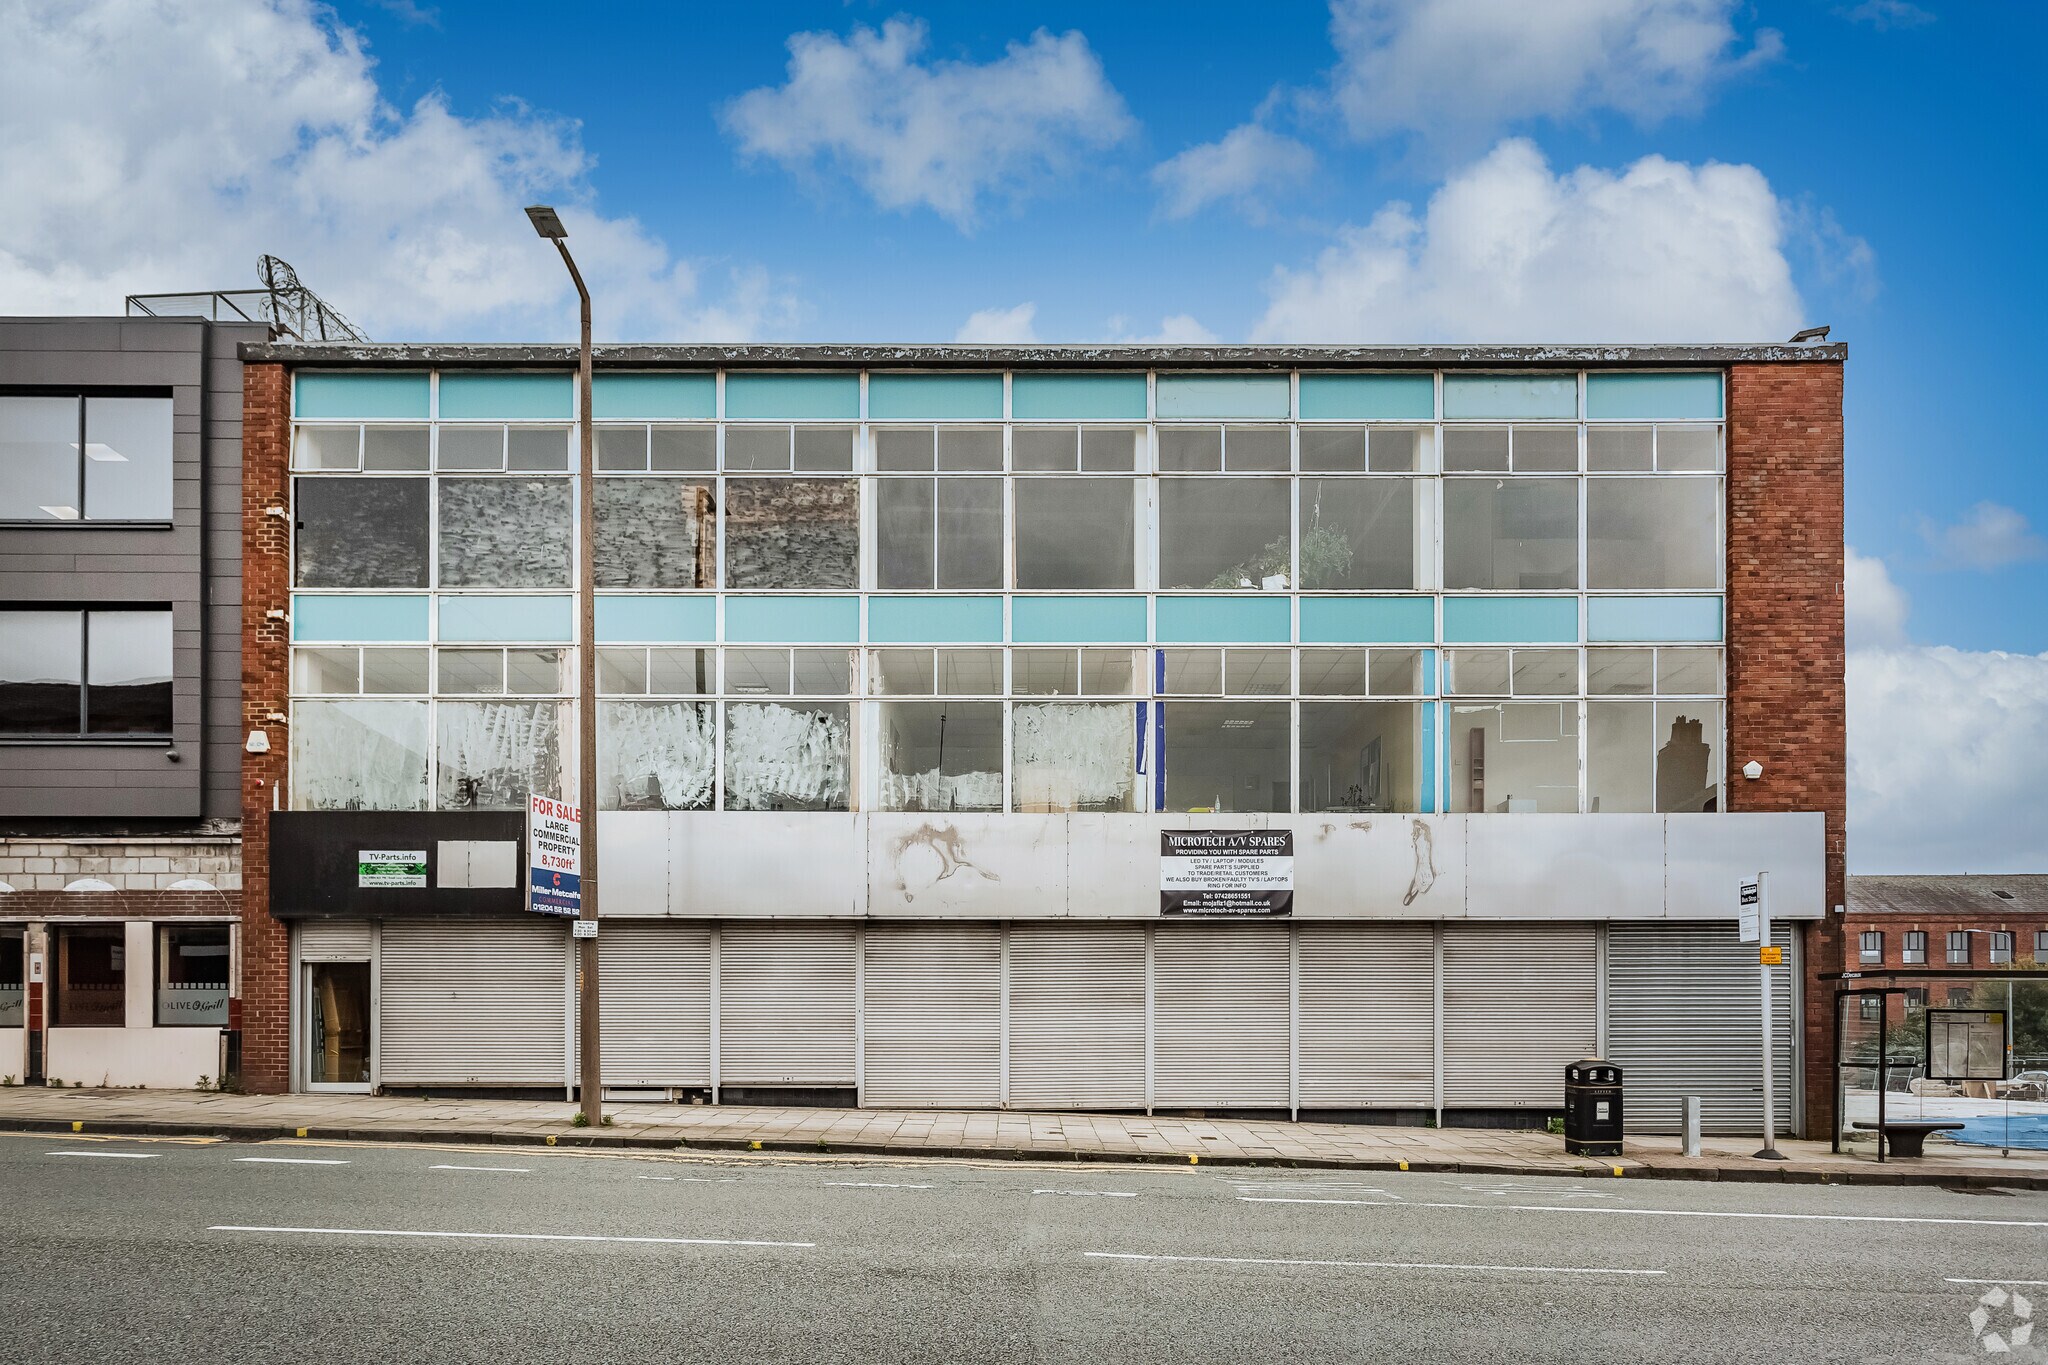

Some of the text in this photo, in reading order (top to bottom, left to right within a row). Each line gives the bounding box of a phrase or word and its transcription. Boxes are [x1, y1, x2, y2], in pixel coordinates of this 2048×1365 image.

[533, 797, 582, 823] FOR SALE
[545, 820, 569, 832] LARGE
[533, 828, 580, 846] COMMERCIAL
[1169, 836, 1286, 847] MICROTECH A/V SPARES
[538, 841, 576, 855] PROPERTY
[369, 853, 417, 861] TV-Parts.info
[531, 885, 581, 899] Miller Metcalfe
[539, 896, 574, 907] COMMERCIAL
[1748, 895, 1757, 903] Stop
[533, 903, 553, 912] 01204
[563, 907, 572, 915] 52
[571, 908, 580, 916] 52
[0, 999, 23, 1011] Grill
